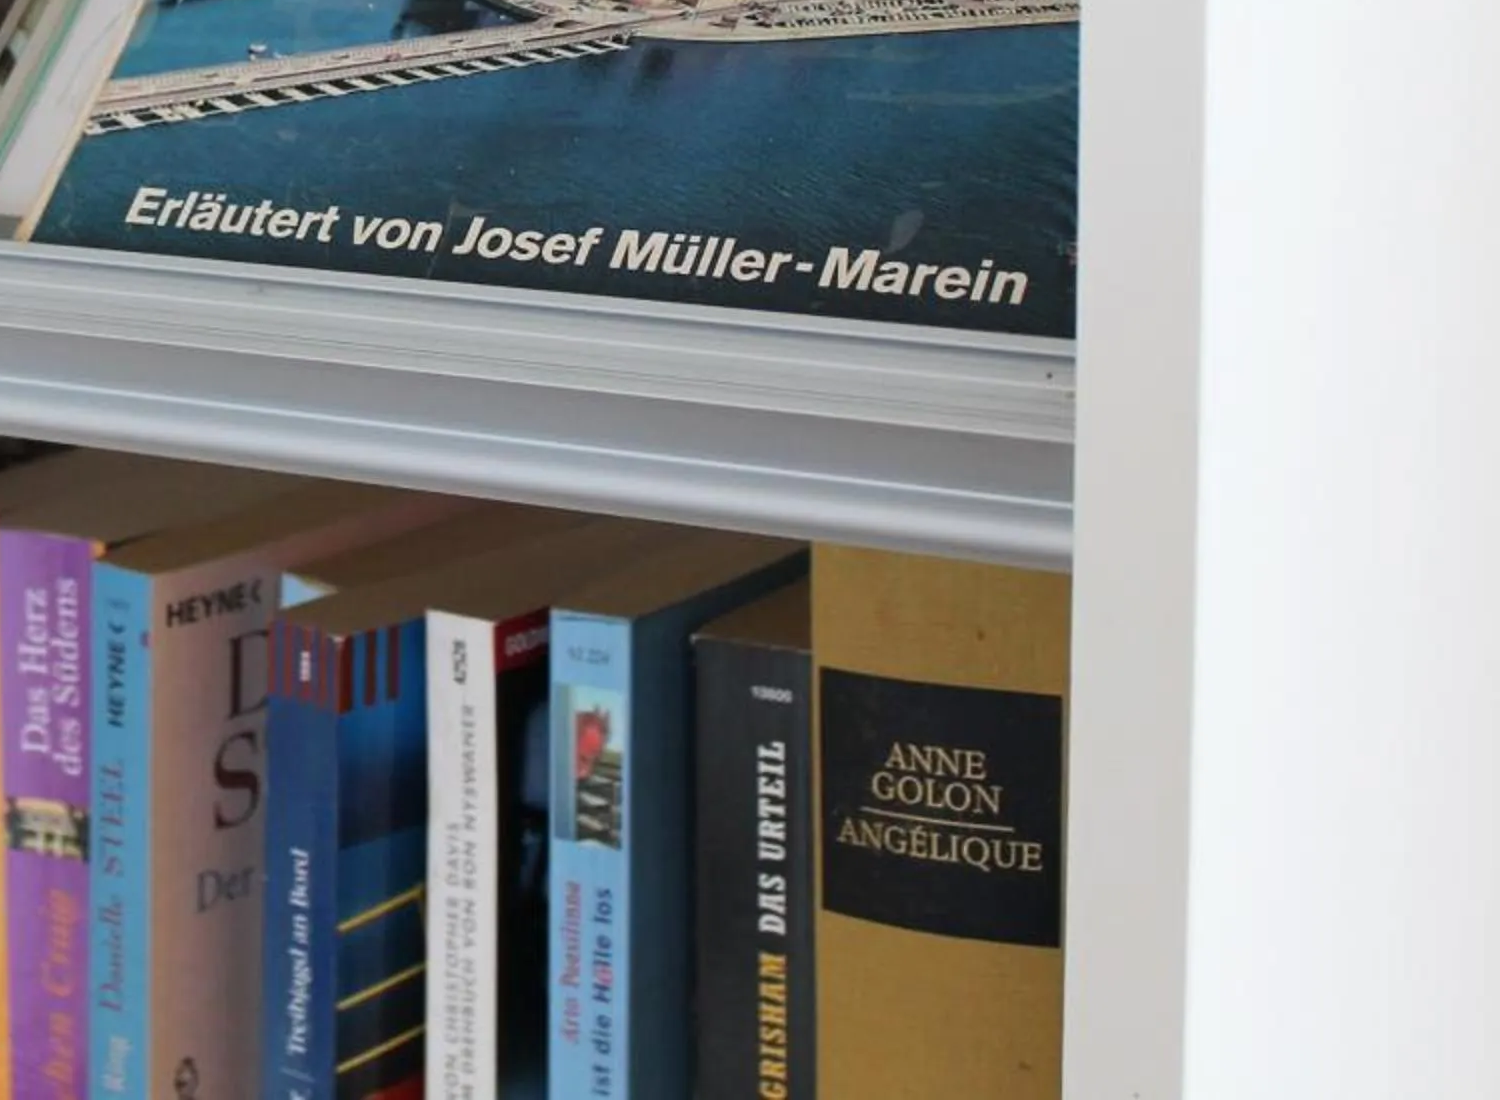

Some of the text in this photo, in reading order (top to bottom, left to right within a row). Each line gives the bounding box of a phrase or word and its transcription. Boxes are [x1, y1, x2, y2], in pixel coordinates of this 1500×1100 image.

[124, 186, 342, 243] Erläutert
[352, 215, 440, 253] von
[453, 215, 599, 268] Josef
[165, 580, 250, 628] HEYNE
[17, 586, 50, 755] Das Herz
[49, 577, 82, 777] des Südens
[106, 637, 127, 728] HEYNE
[460, 702, 477, 833] NYSWANER
[871, 774, 1004, 815] GOLON
[884, 743, 987, 782] ANNE
[97, 758, 125, 877] STEEL
[443, 822, 460, 887] DAVIS
[837, 816, 1044, 873] ANGÉLIQUE
[287, 846, 311, 909] Bord
[460, 839, 477, 890] RON
[291, 913, 310, 945] an
[459, 897, 477, 948] VON
[757, 740, 788, 1100] GRISHAM DAS URTEIL
[443, 896, 460, 1045] CHRISTOPHER
[591, 886, 614, 1097] ist die Hölle los
[458, 958, 476, 1075] DREHBUCH
